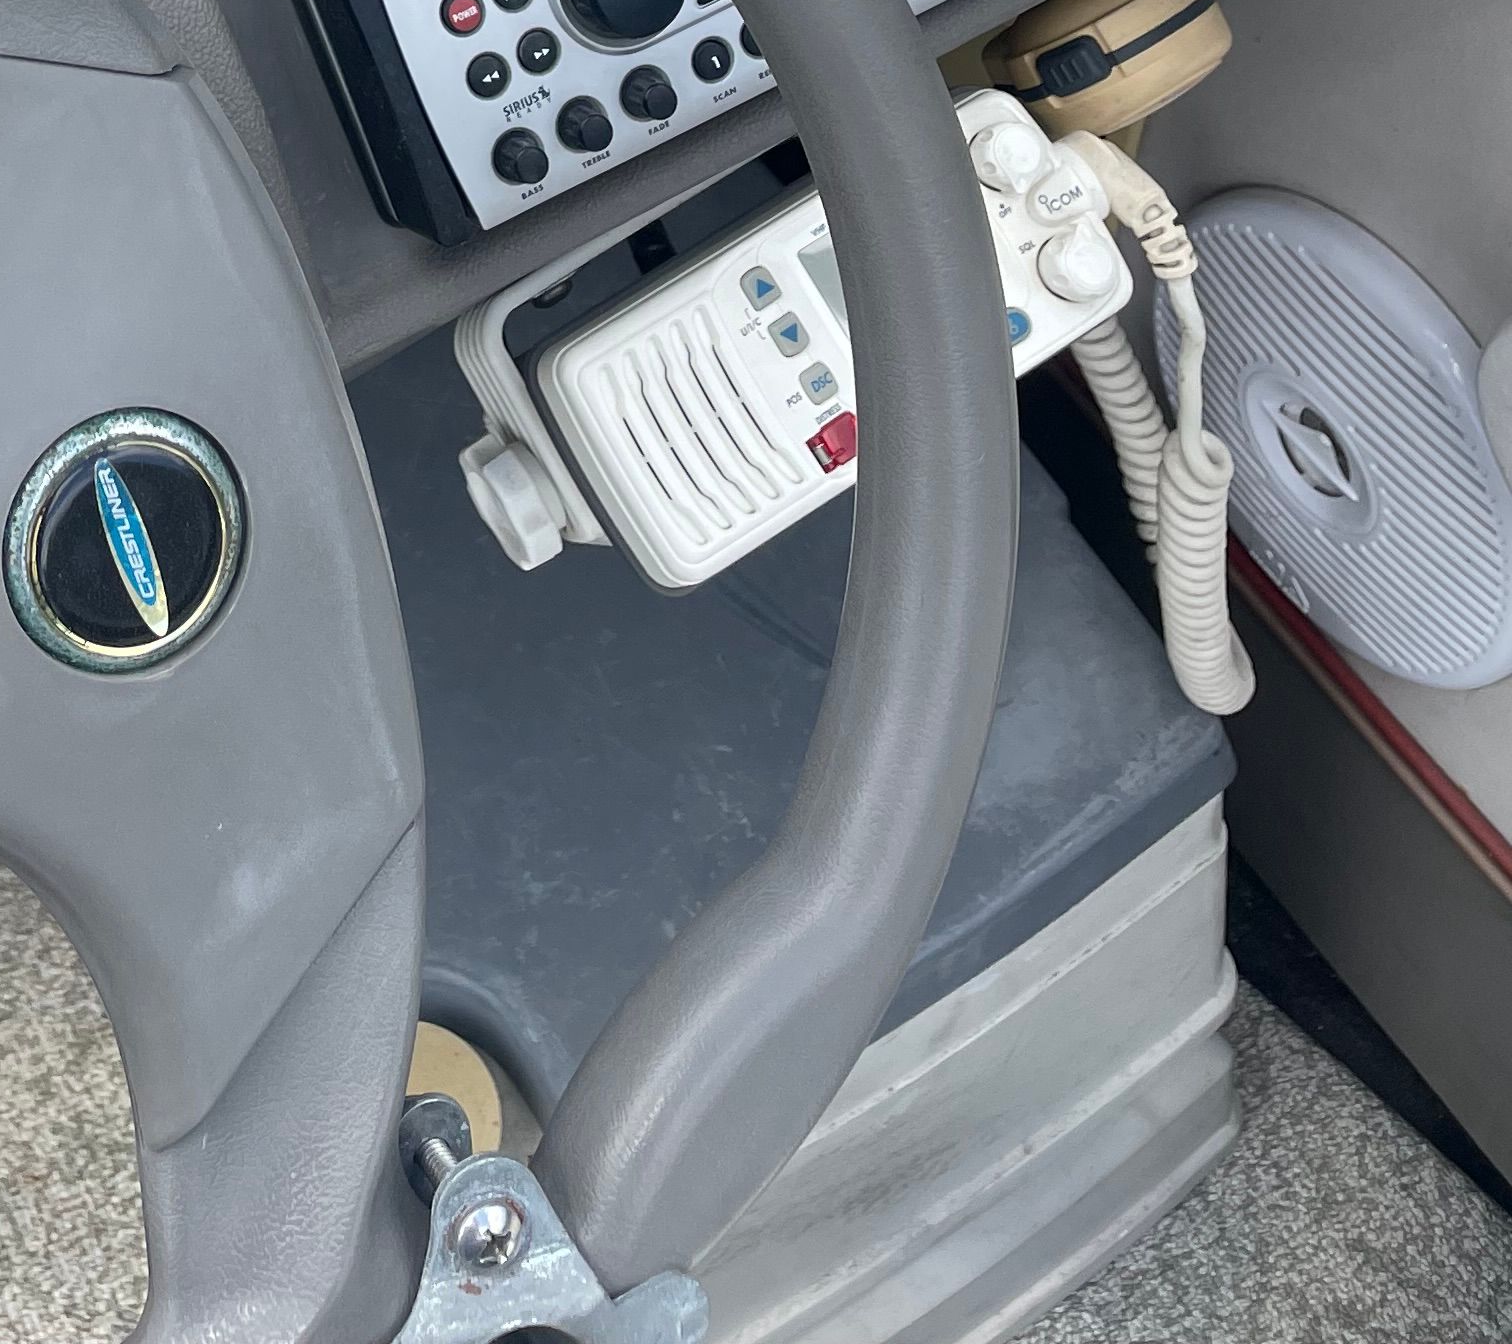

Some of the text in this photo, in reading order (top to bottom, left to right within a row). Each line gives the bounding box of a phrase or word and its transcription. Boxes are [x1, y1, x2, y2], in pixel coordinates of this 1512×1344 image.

[452, 5, 479, 24] POWER
[710, 55, 721, 69] 1
[712, 86, 737, 104] SCAN
[502, 92, 540, 118] SIRIUS
[505, 96, 553, 123] READY
[648, 120, 671, 136] FADE
[581, 150, 612, 170] TREBLE
[521, 184, 545, 200] BASS
[1018, 239, 1036, 255] SQL
[810, 371, 833, 393] DSC
[786, 391, 803, 409] POS
[97, 466, 155, 600] CRESTLINER
